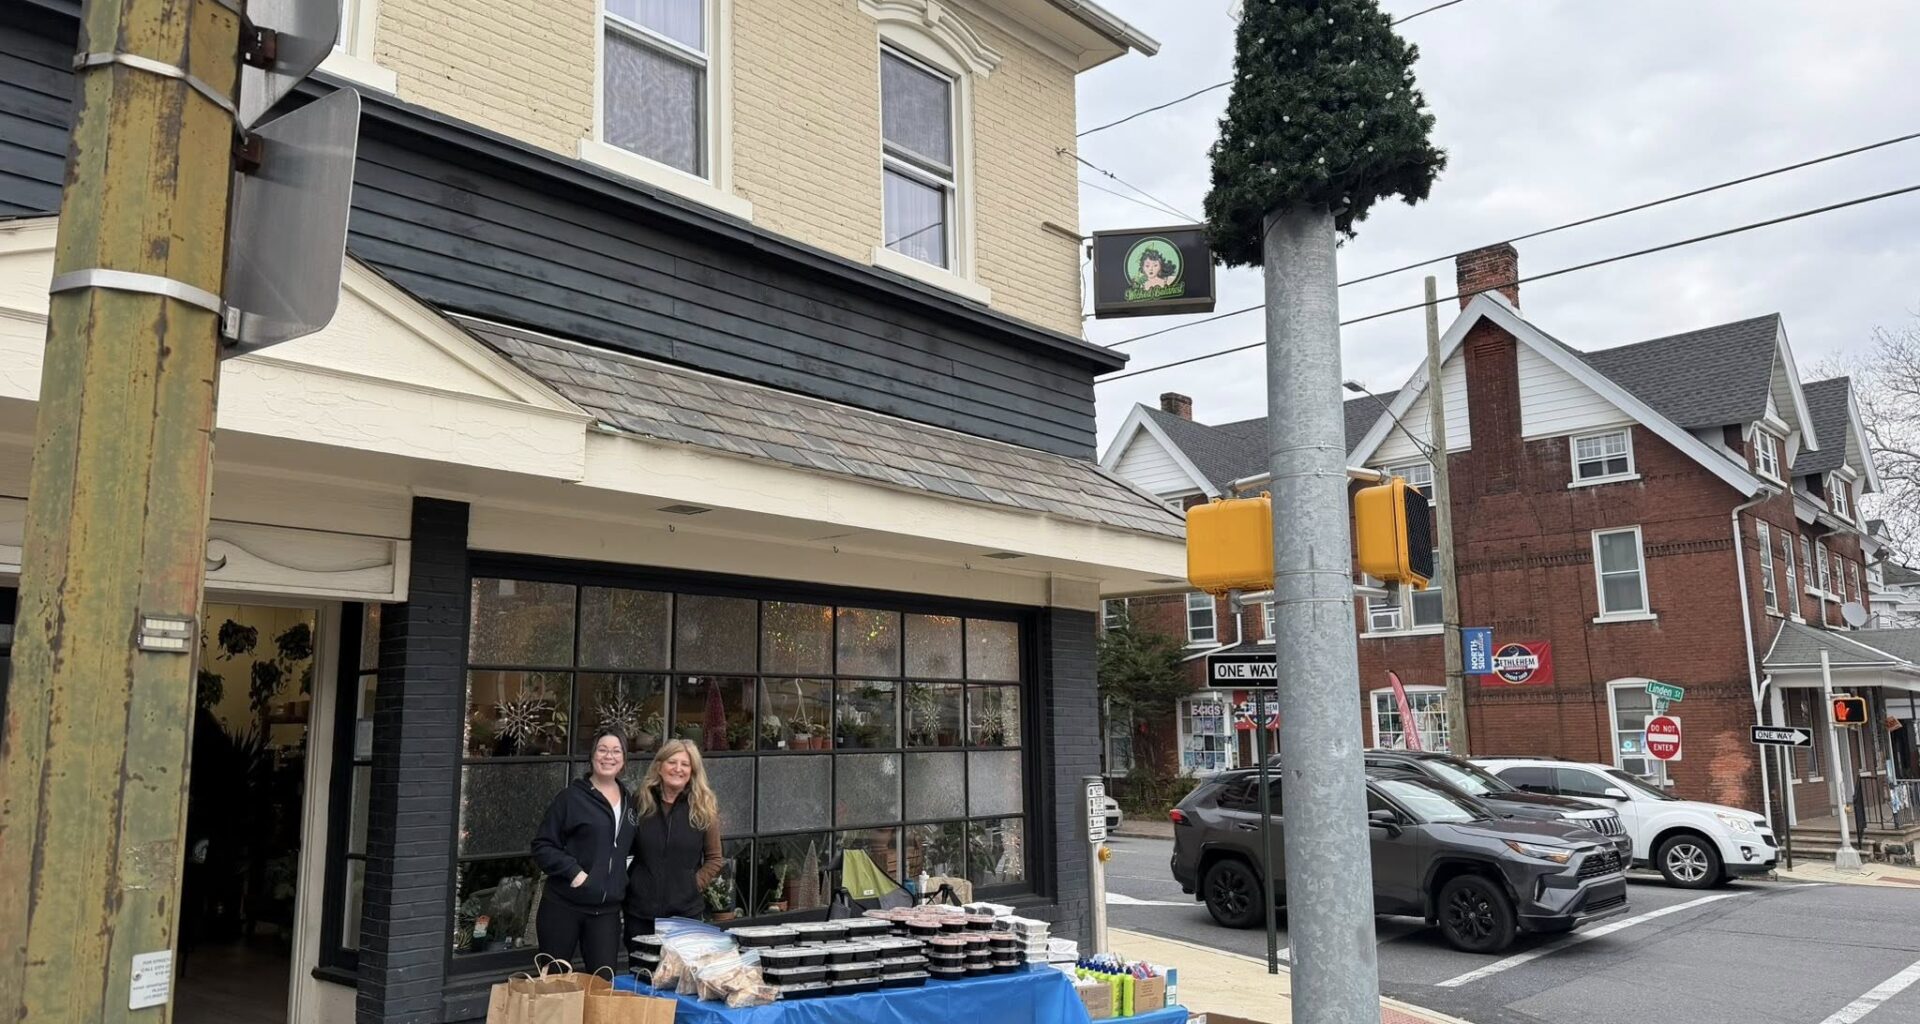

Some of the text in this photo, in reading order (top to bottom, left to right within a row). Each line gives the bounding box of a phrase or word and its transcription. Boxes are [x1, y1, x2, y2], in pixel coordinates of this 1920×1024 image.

[1470, 640, 1478, 670] NORTH
[1478, 652, 1486, 670] SIDE
[1217, 664, 1278, 678] ONE WAY
[1648, 682, 1673, 697] Linden
[1650, 724, 1660, 732] DO
[1757, 732, 1793, 740] ONE WAY
[1653, 743, 1674, 752] ENTER
